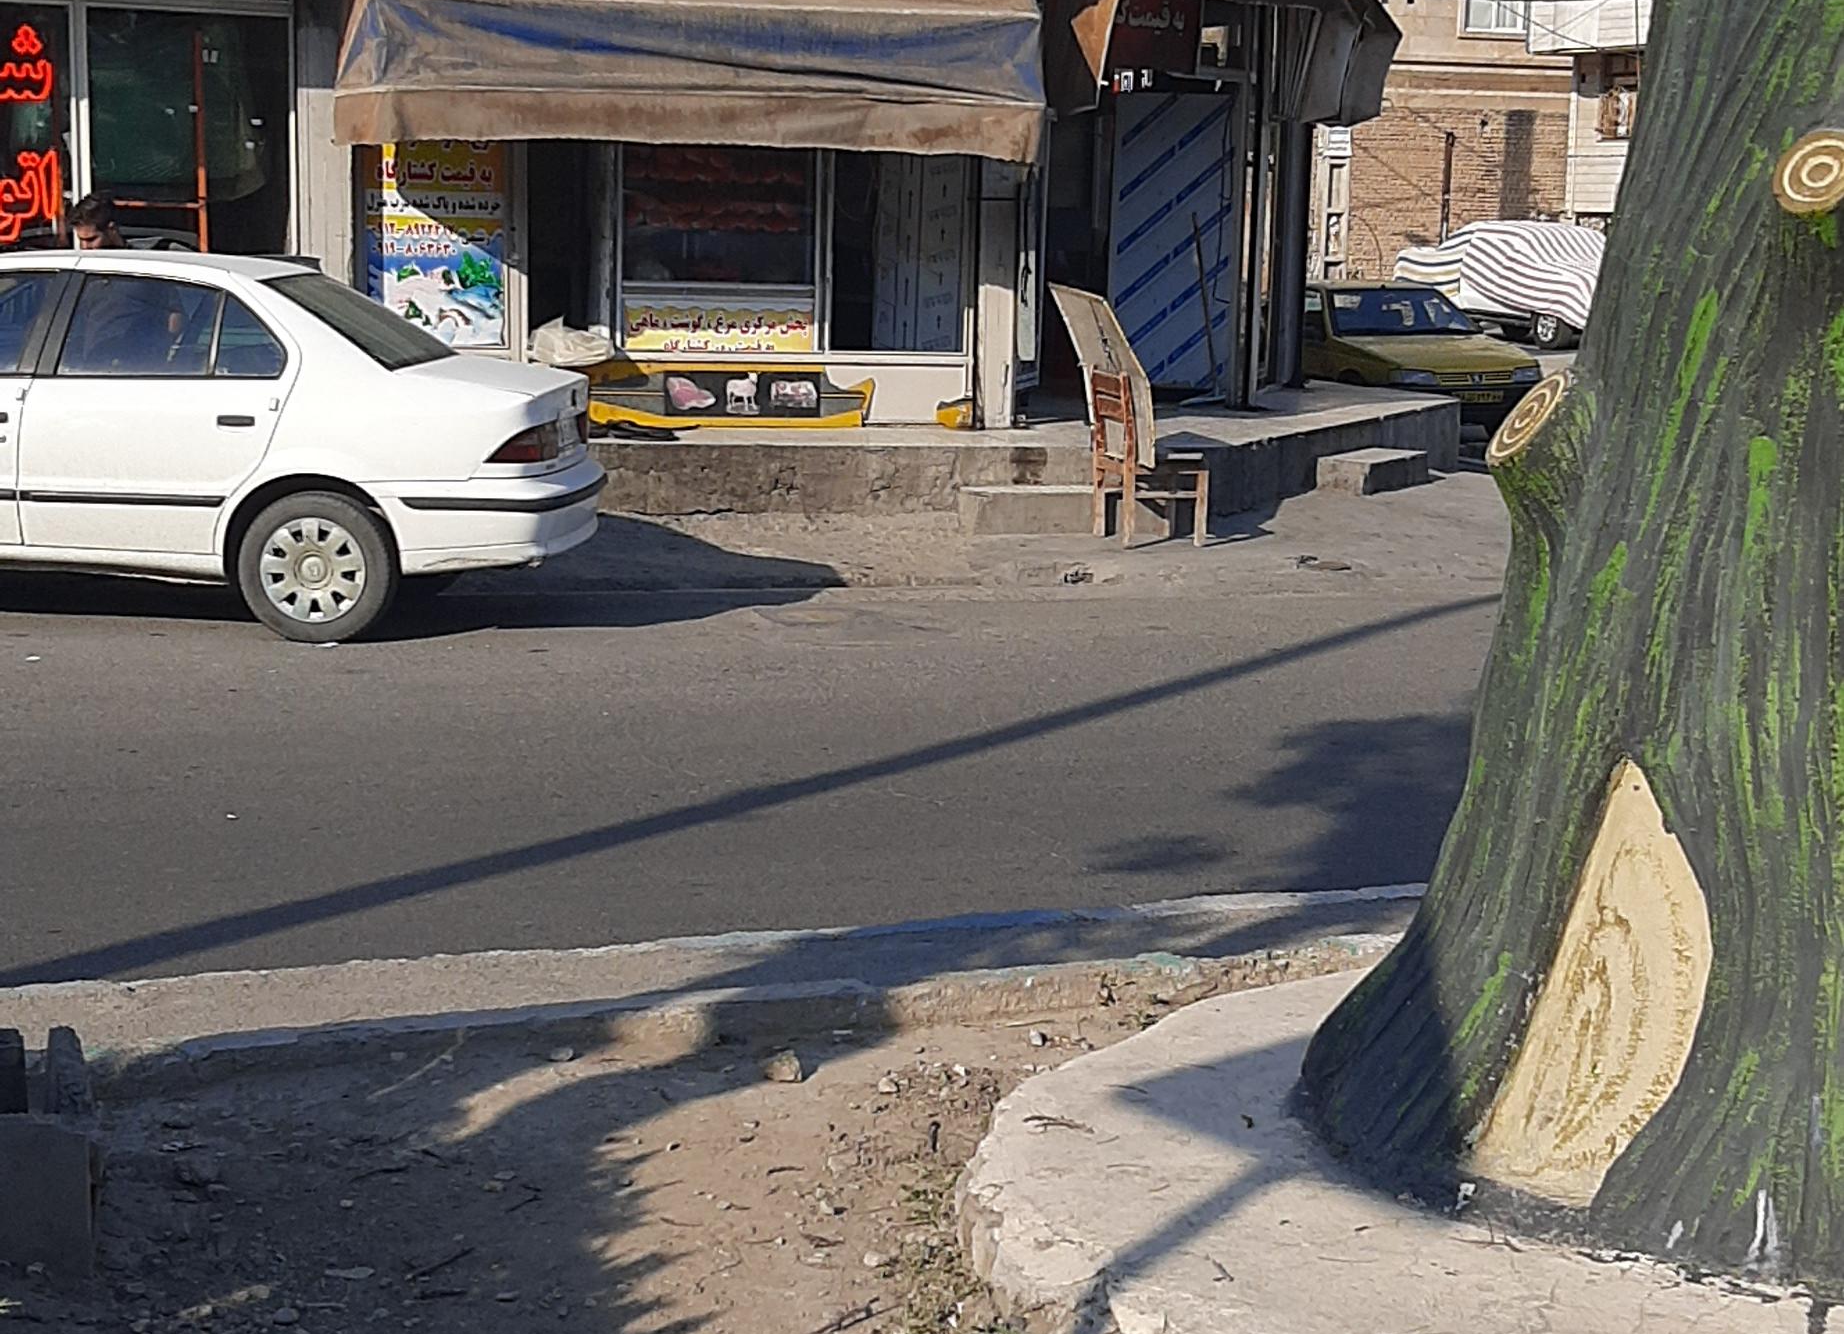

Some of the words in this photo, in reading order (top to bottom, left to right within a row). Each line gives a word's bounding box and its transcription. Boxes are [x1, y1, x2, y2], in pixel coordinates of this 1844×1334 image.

[1128, 1, 1171, 35] قیمت
[440, 161, 476, 186] قیمت
[479, 166, 493, 186] به
[432, 196, 449, 214] پاک
[671, 313, 704, 333] گوشت
[715, 313, 737, 335] مرغ
[740, 316, 776, 334] مرکزی
[780, 318, 808, 338] پخش
